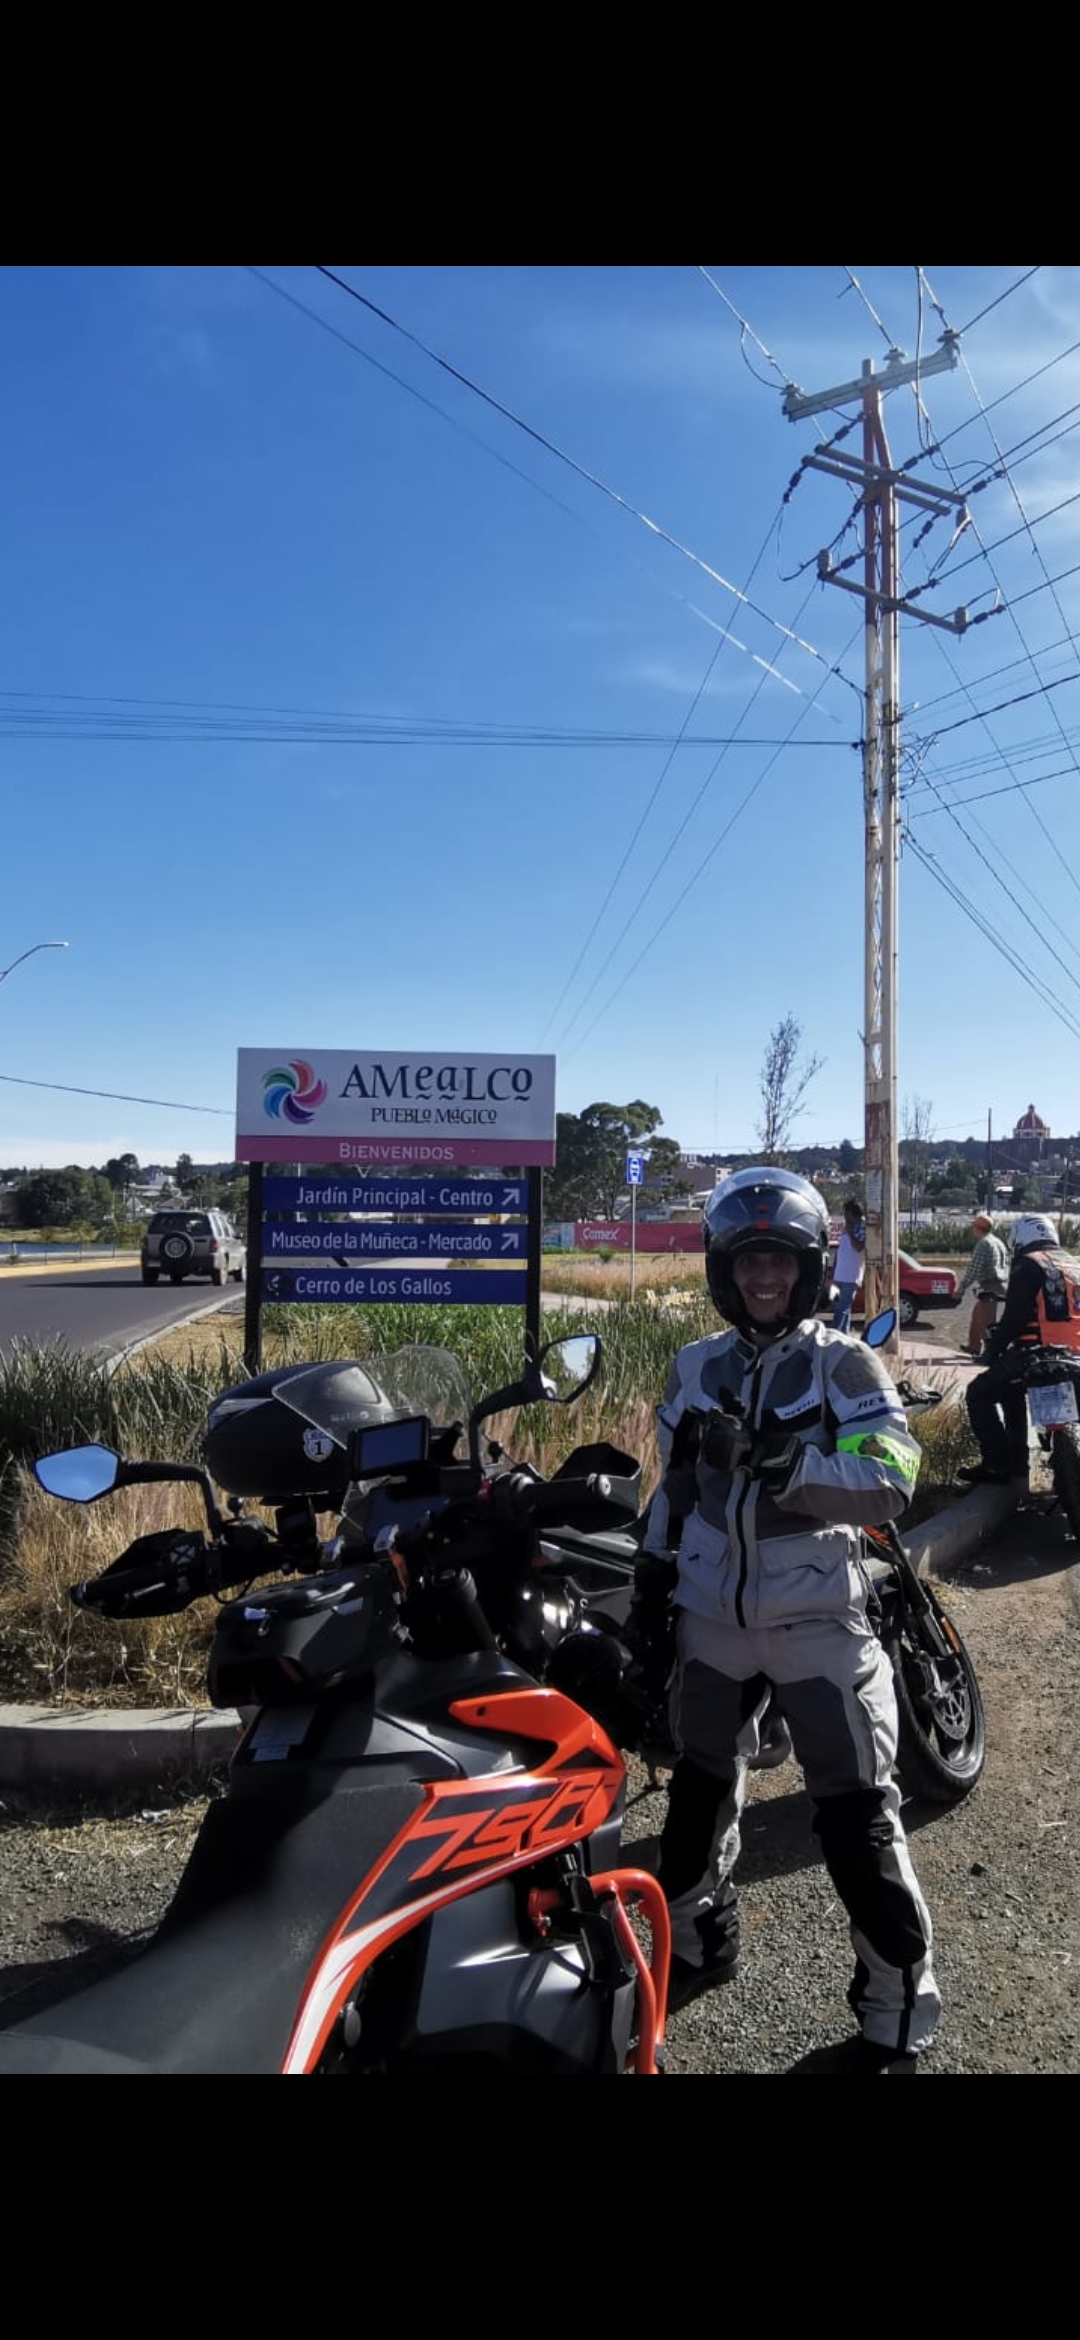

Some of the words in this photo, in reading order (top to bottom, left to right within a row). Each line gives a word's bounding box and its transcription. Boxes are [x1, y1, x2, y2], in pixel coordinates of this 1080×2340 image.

[296, 1186, 347, 1205] Jardín
[352, 1188, 425, 1208] Principal
[440, 1189, 493, 1206] Centro
[272, 1232, 321, 1249] Museo
[323, 1233, 343, 1248] de
[345, 1233, 358, 1248] la
[361, 1233, 418, 1250] Muñeca
[429, 1234, 492, 1251] Mercado
[296, 1277, 339, 1294] Cerro
[344, 1277, 365, 1294] de
[370, 1278, 396, 1295] Los
[401, 1278, 451, 1295] Gallos
